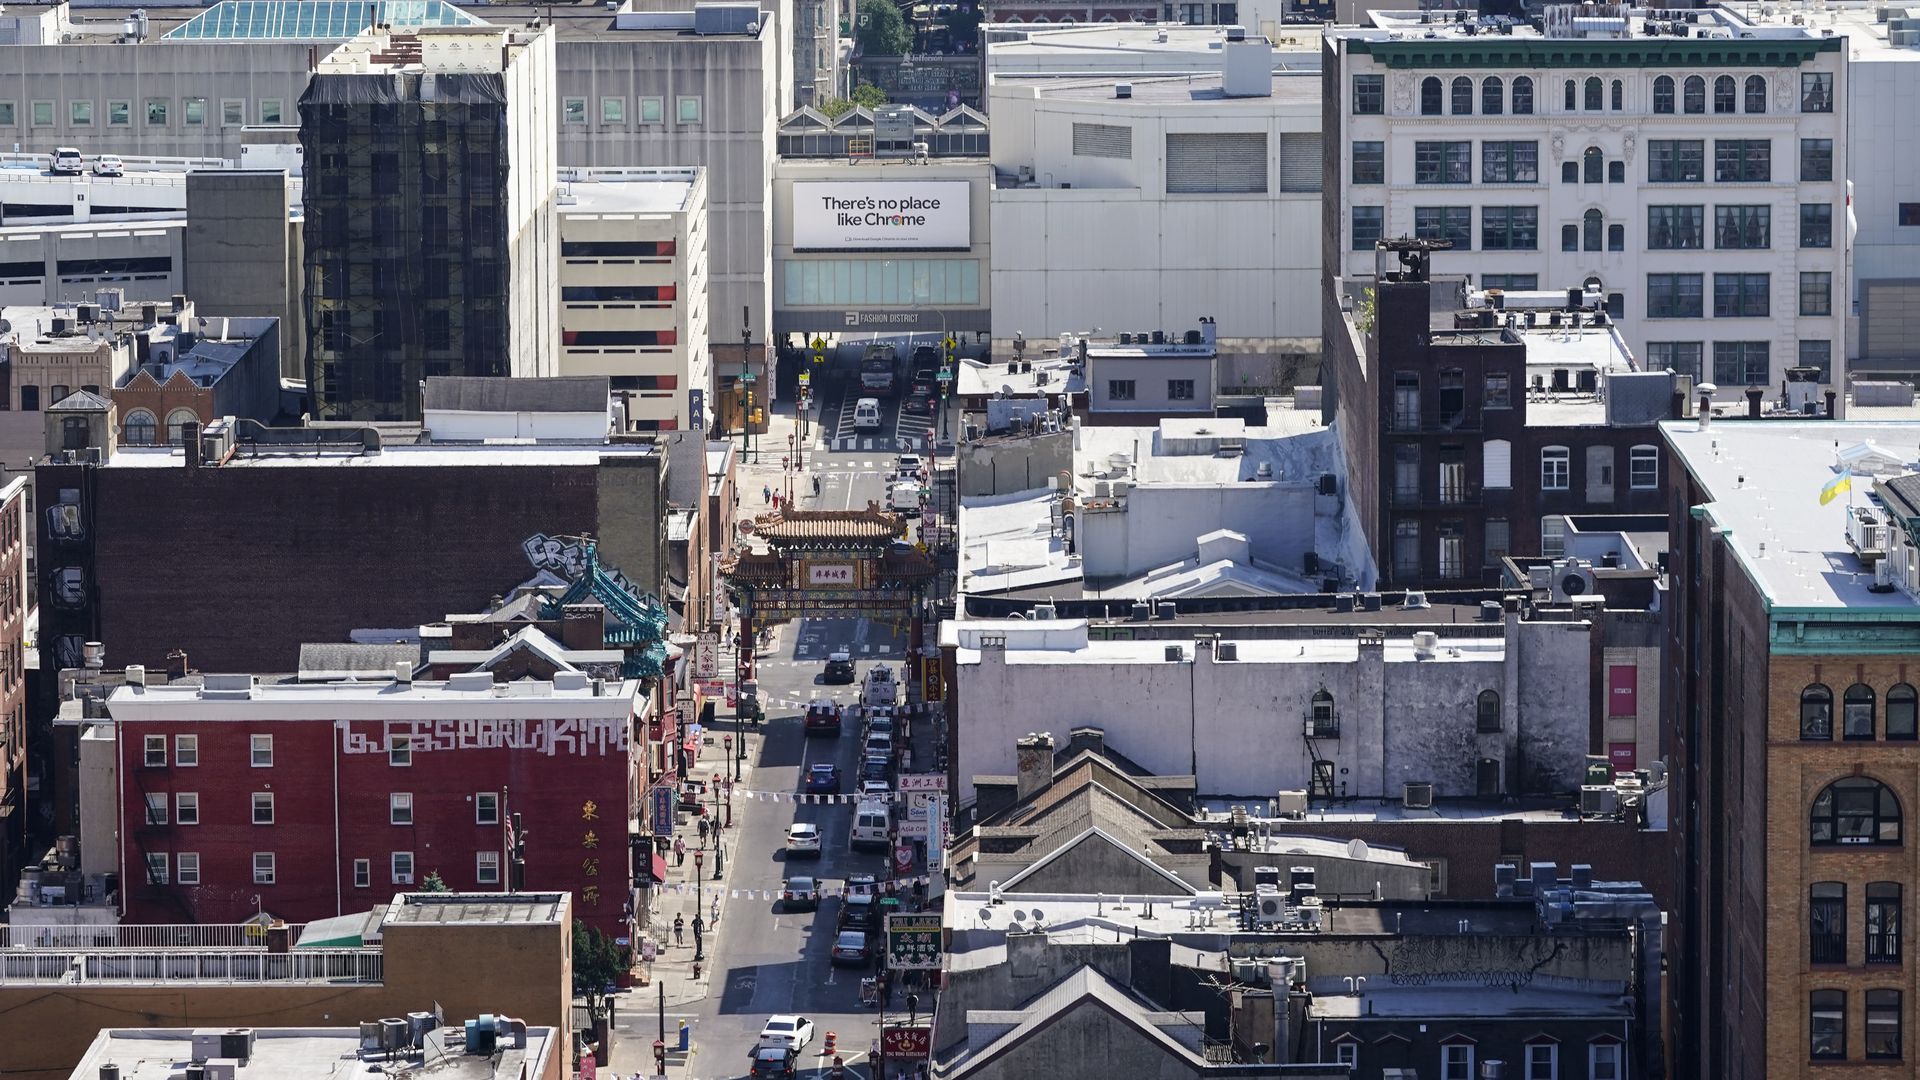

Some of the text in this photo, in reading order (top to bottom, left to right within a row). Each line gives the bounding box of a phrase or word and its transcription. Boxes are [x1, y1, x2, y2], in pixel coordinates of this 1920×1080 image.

[911, 54, 942, 62] Jefferson
[822, 196, 940, 212] There's no place
[837, 213, 926, 226] like Chrome
[860, 314, 918, 322] FASHION DISTRICT
